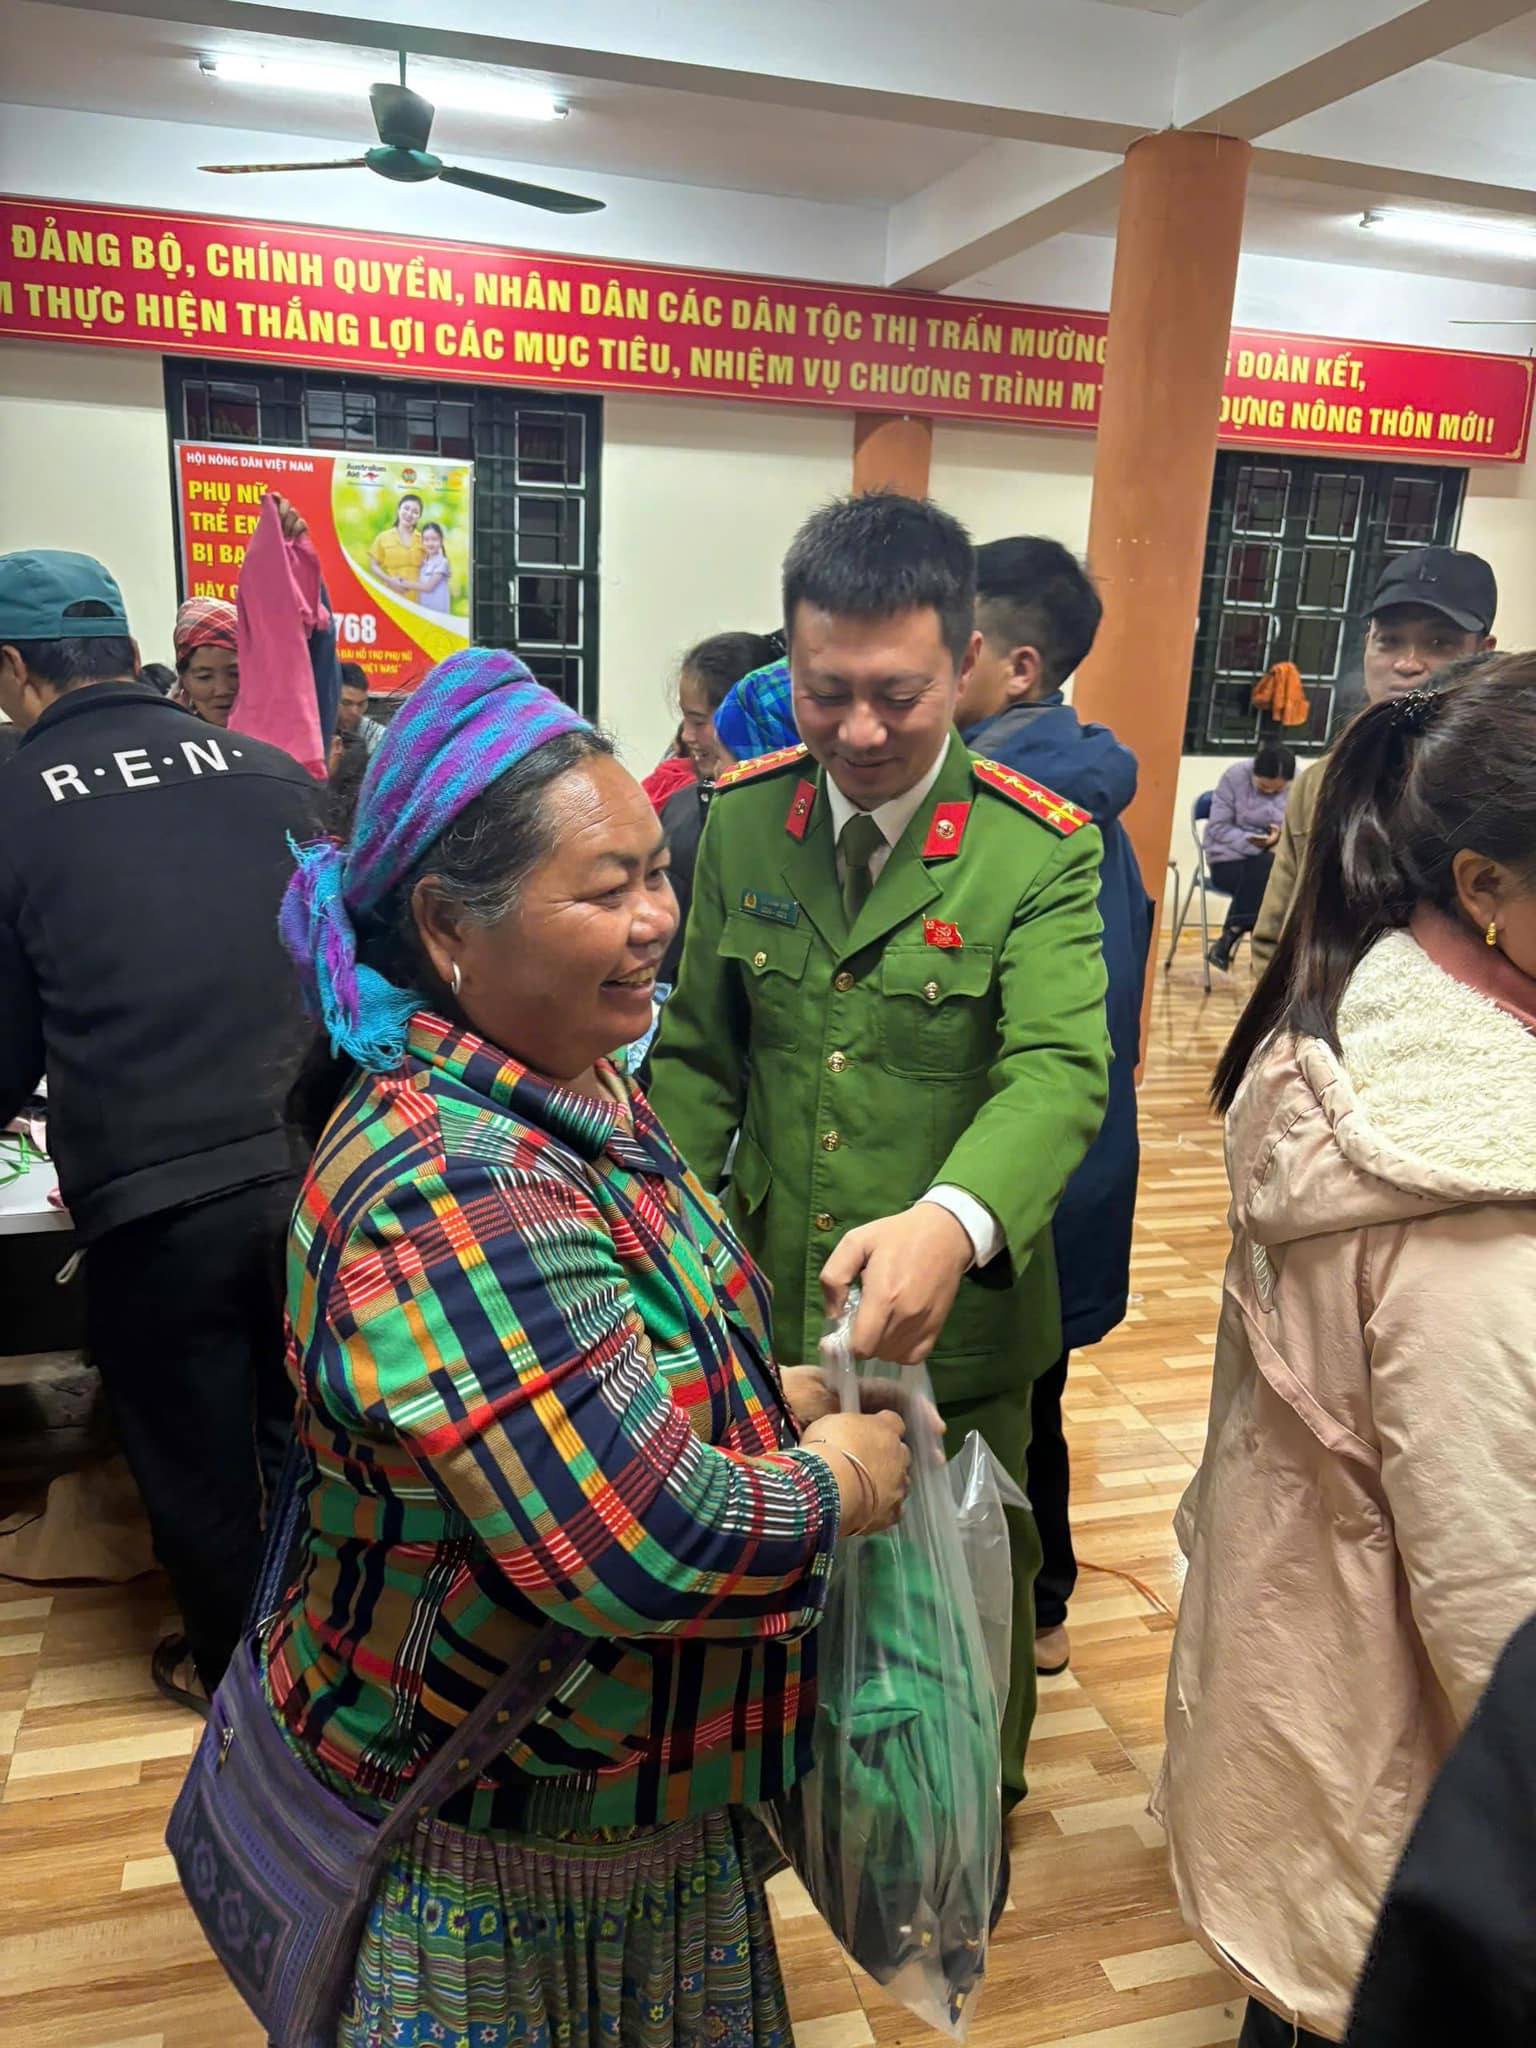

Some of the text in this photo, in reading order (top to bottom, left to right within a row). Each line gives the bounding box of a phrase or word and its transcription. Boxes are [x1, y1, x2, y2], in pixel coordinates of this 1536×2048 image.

[12, 217, 120, 266] ĐẢNG
[132, 232, 195, 279] BỘ,
[207, 244, 322, 287] CHÍNH
[333, 256, 464, 306] QUYỀN,
[474, 271, 570, 312] NHÂN
[581, 280, 648, 320] DÂN
[659, 289, 721, 326] CÁC
[732, 298, 795, 333] DÂN
[807, 304, 861, 343] TỘC
[873, 313, 917, 350] THỊ
[928, 318, 1001, 353] TRẤN
[1011, 323, 1107, 365] MƯỜNG
[1237, 350, 1310, 384] ĐOÀN
[1315, 352, 1364, 392] KẾT,
[24, 284, 124, 328] THỰC
[136, 290, 226, 337] HIỆN
[236, 297, 359, 346] THẮNG
[369, 317, 424, 358] LỢI
[435, 320, 504, 360] CÁC
[514, 331, 589, 372] MỤC
[599, 336, 680, 378] TIÊU,
[691, 347, 793, 388] NHIỆM
[804, 358, 840, 393] VỤ
[850, 362, 970, 399] CHƯƠNG
[980, 368, 1062, 409] TRÌNH
[1071, 380, 1104, 411] M
[1291, 399, 1362, 433] NÔNG
[1369, 406, 1433, 438] THÔN
[1438, 412, 1494, 443] MỚI!
[186, 452, 314, 472] HỘI NÔNG DÂN VIỆT NAM
[189, 480, 268, 506] PHỤ NỮ
[190, 507, 228, 532] TRẺ
[192, 543, 245, 568] BỊ BẠ
[332, 613, 376, 643] 768
